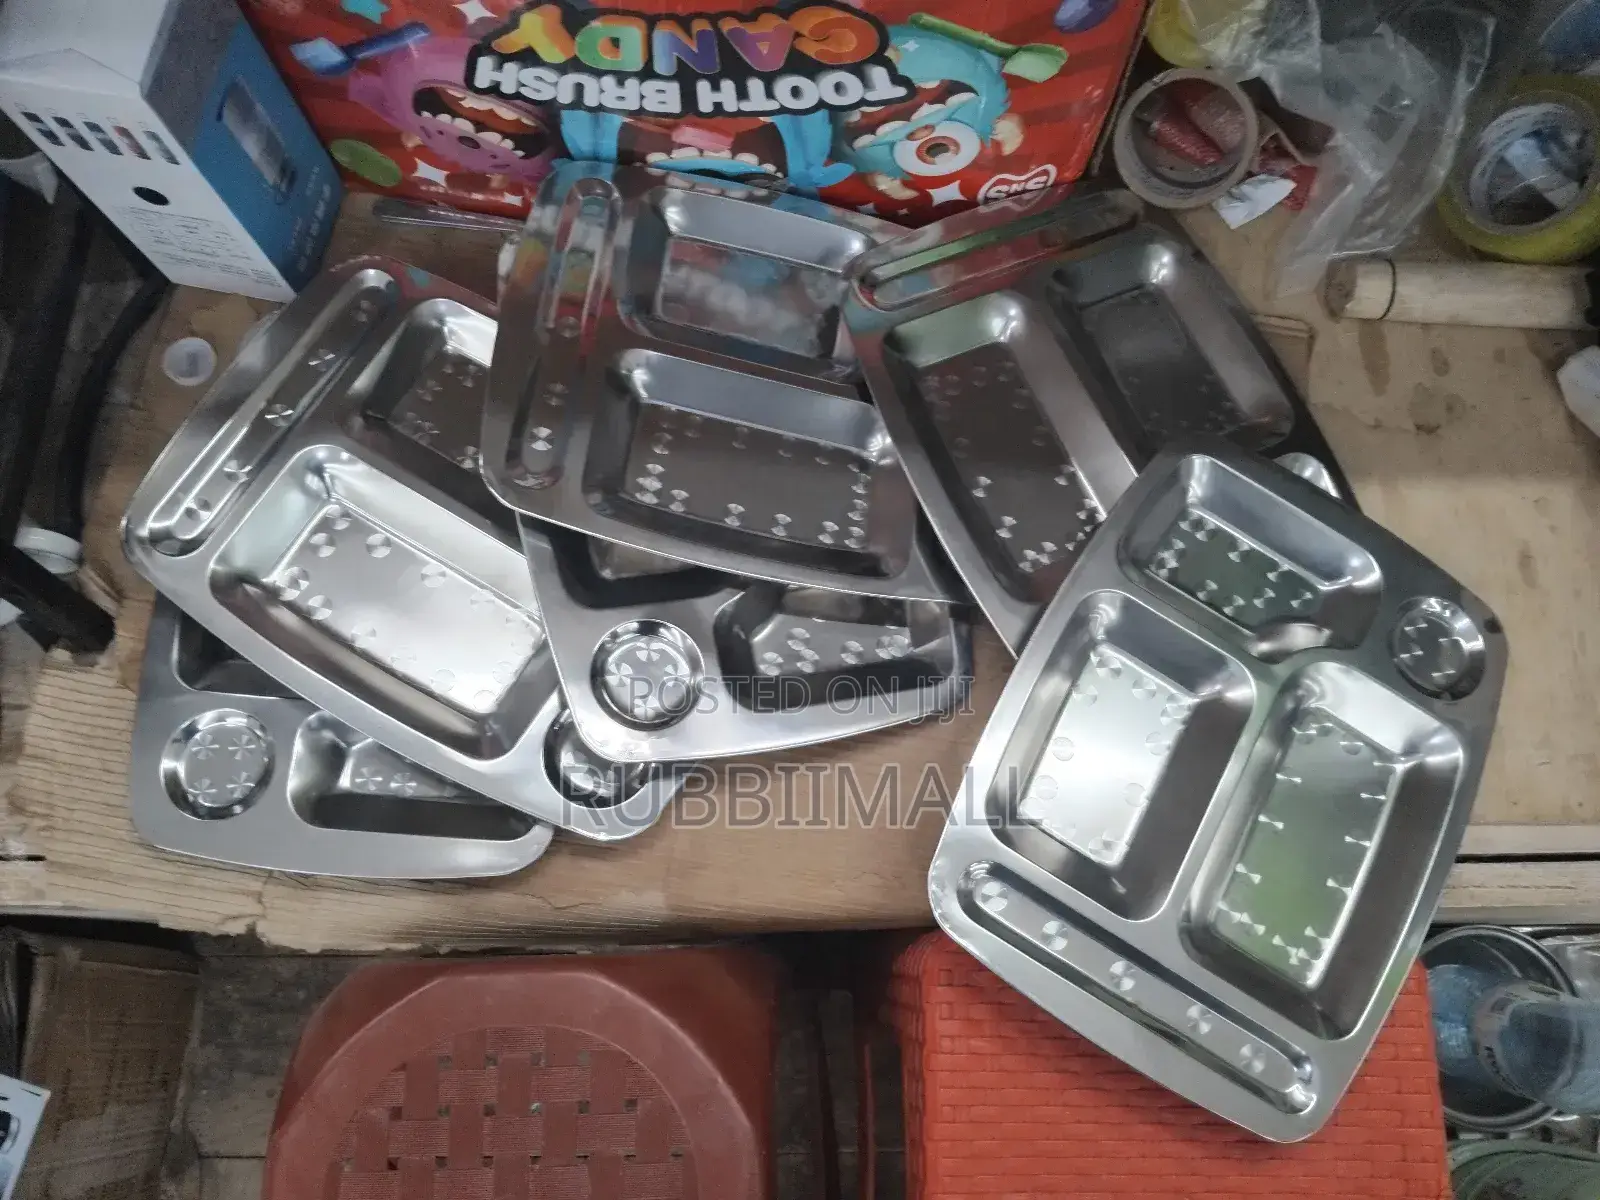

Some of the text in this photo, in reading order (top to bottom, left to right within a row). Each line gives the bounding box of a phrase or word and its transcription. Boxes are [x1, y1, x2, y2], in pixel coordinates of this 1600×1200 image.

[491, 4, 880, 75] CANDY
[474, 56, 908, 113] TOOTH BRUSH
